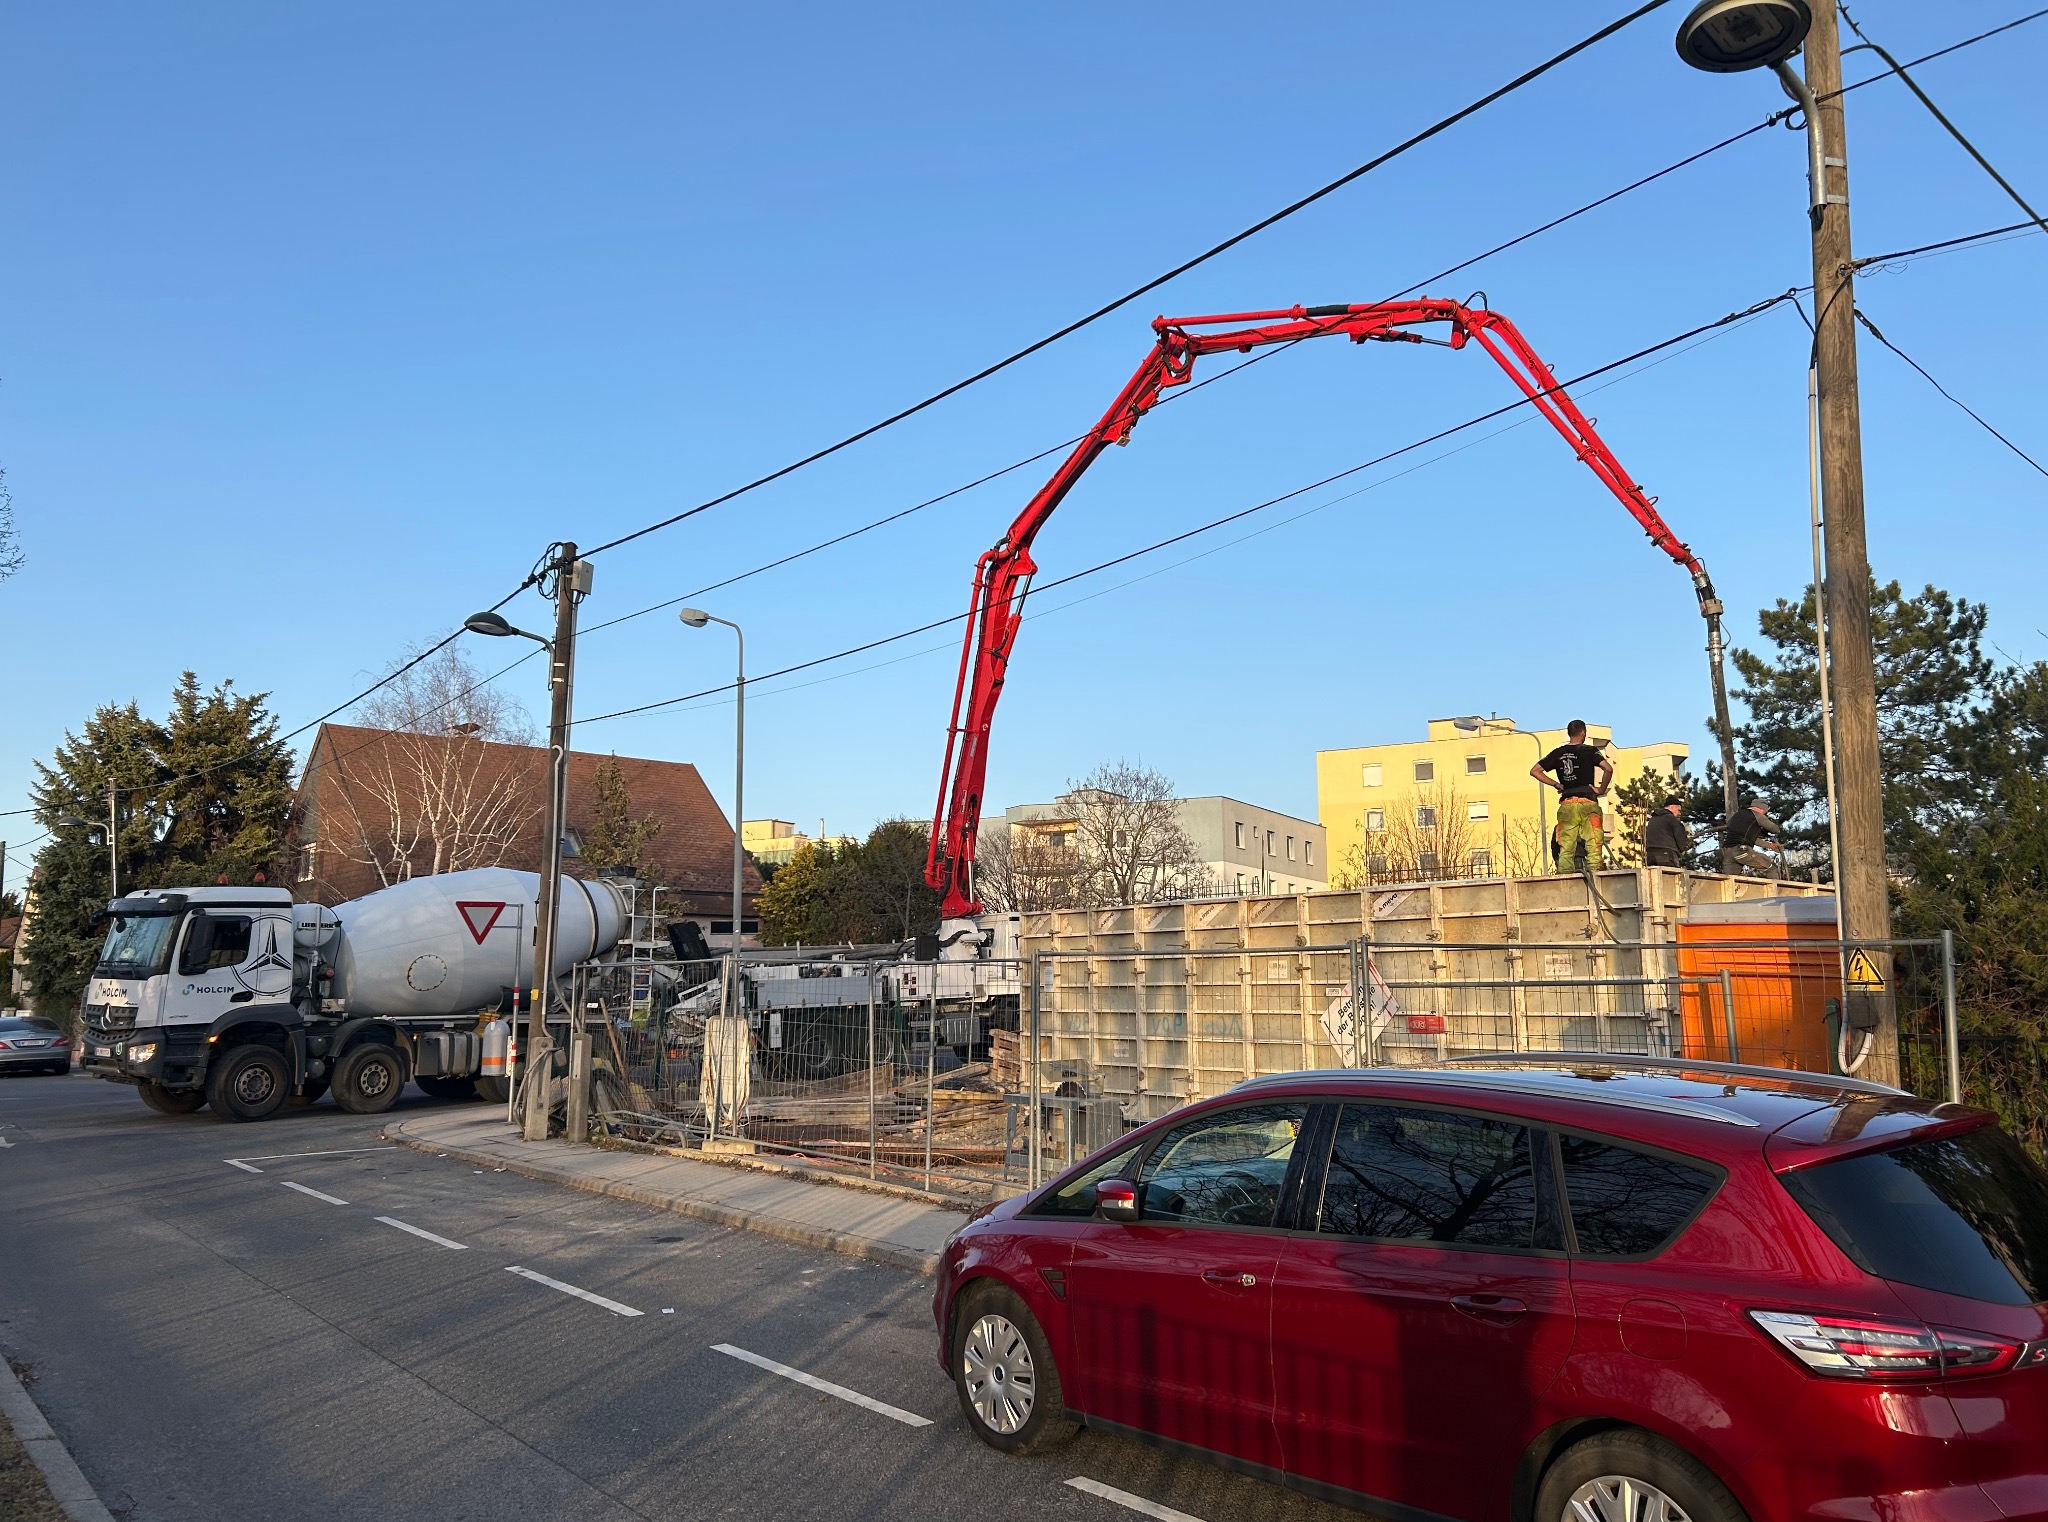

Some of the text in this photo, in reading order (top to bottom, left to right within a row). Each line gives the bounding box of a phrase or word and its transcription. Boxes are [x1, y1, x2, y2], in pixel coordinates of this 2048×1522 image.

[101, 987, 128, 998] HOLCIM
[196, 986, 235, 994] HOLCIM
[1337, 1020, 1349, 1035] der
